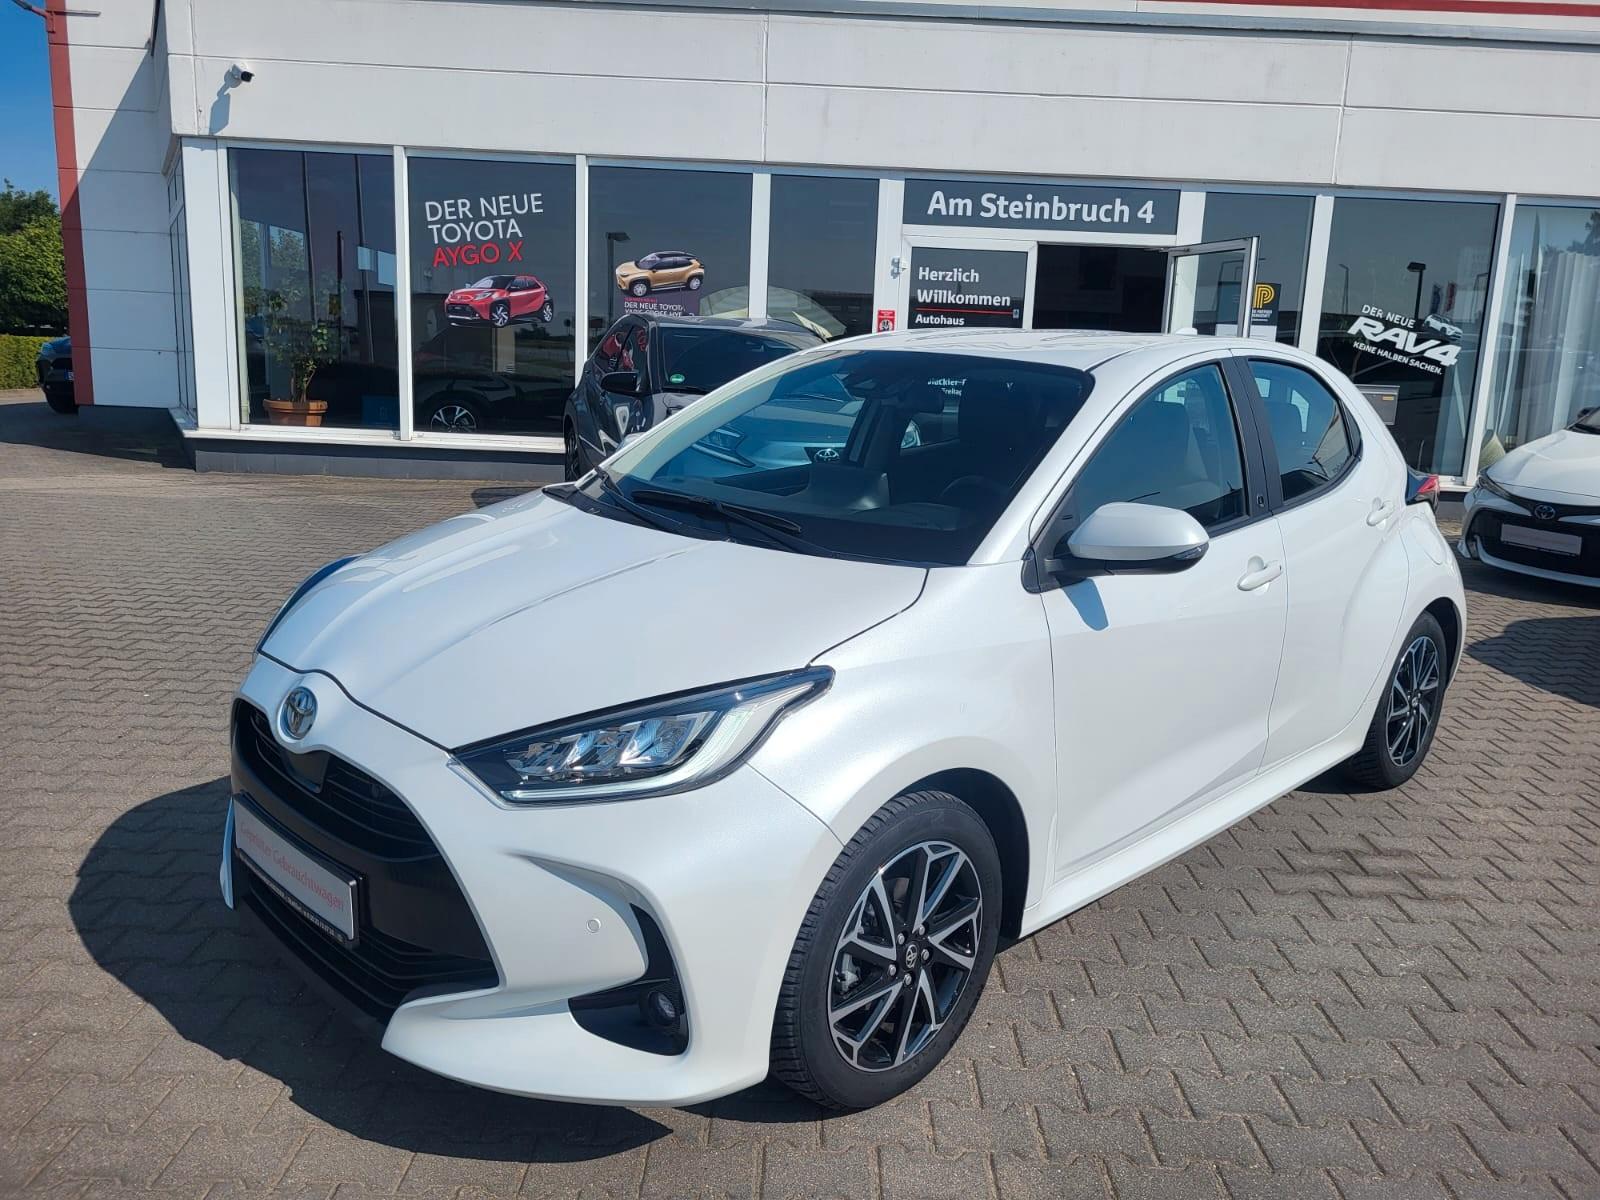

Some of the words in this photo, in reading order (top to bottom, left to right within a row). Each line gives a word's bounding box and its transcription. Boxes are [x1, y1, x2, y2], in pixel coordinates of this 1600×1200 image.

[425, 197, 472, 221] DER
[480, 193, 543, 216] NEUE
[927, 190, 973, 217] Am
[980, 193, 1130, 223] Steinbruch
[1137, 200, 1154, 224] 4
[428, 219, 522, 244] TOYOTA
[433, 242, 500, 267] AYGO
[507, 241, 522, 262] X
[918, 266, 980, 284] Herzlich
[639, 302, 658, 310] NEUE
[917, 289, 1011, 307] Willkommen
[915, 313, 965, 326] Autohaus
[1362, 304, 1383, 318] DER
[1386, 312, 1416, 329] NEUE
[1347, 316, 1462, 367] RAV4
[1352, 341, 1376, 354] KEINE
[1377, 347, 1408, 365] HALBEN
[1408, 357, 1443, 375] SACHEN.
